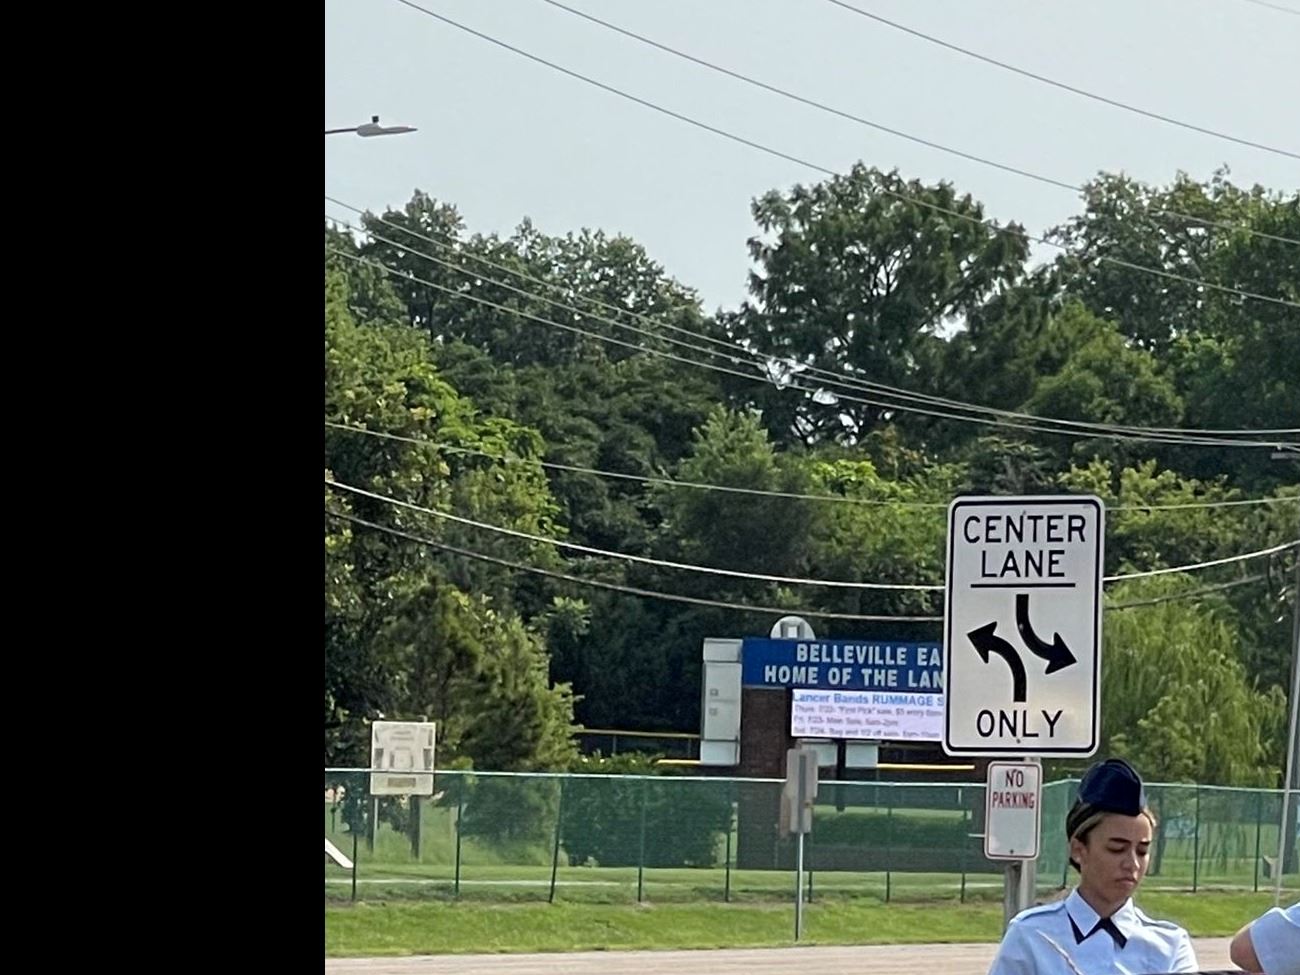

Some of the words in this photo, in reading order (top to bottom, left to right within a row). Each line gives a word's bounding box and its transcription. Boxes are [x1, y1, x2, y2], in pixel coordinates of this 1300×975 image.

[963, 515, 1087, 544] CENTER
[981, 549, 1065, 578] LANE
[796, 643, 907, 666] BELLEVILLE
[764, 665, 818, 685] HOME
[828, 667, 851, 686] OF
[861, 668, 897, 687] THE
[793, 689, 830, 703] Lancer
[833, 692, 869, 704] Bands
[872, 693, 933, 707] RUMMAGE
[976, 709, 1064, 738] ONLY
[1005, 770, 1024, 788] NO
[992, 791, 1035, 809] PARKING
